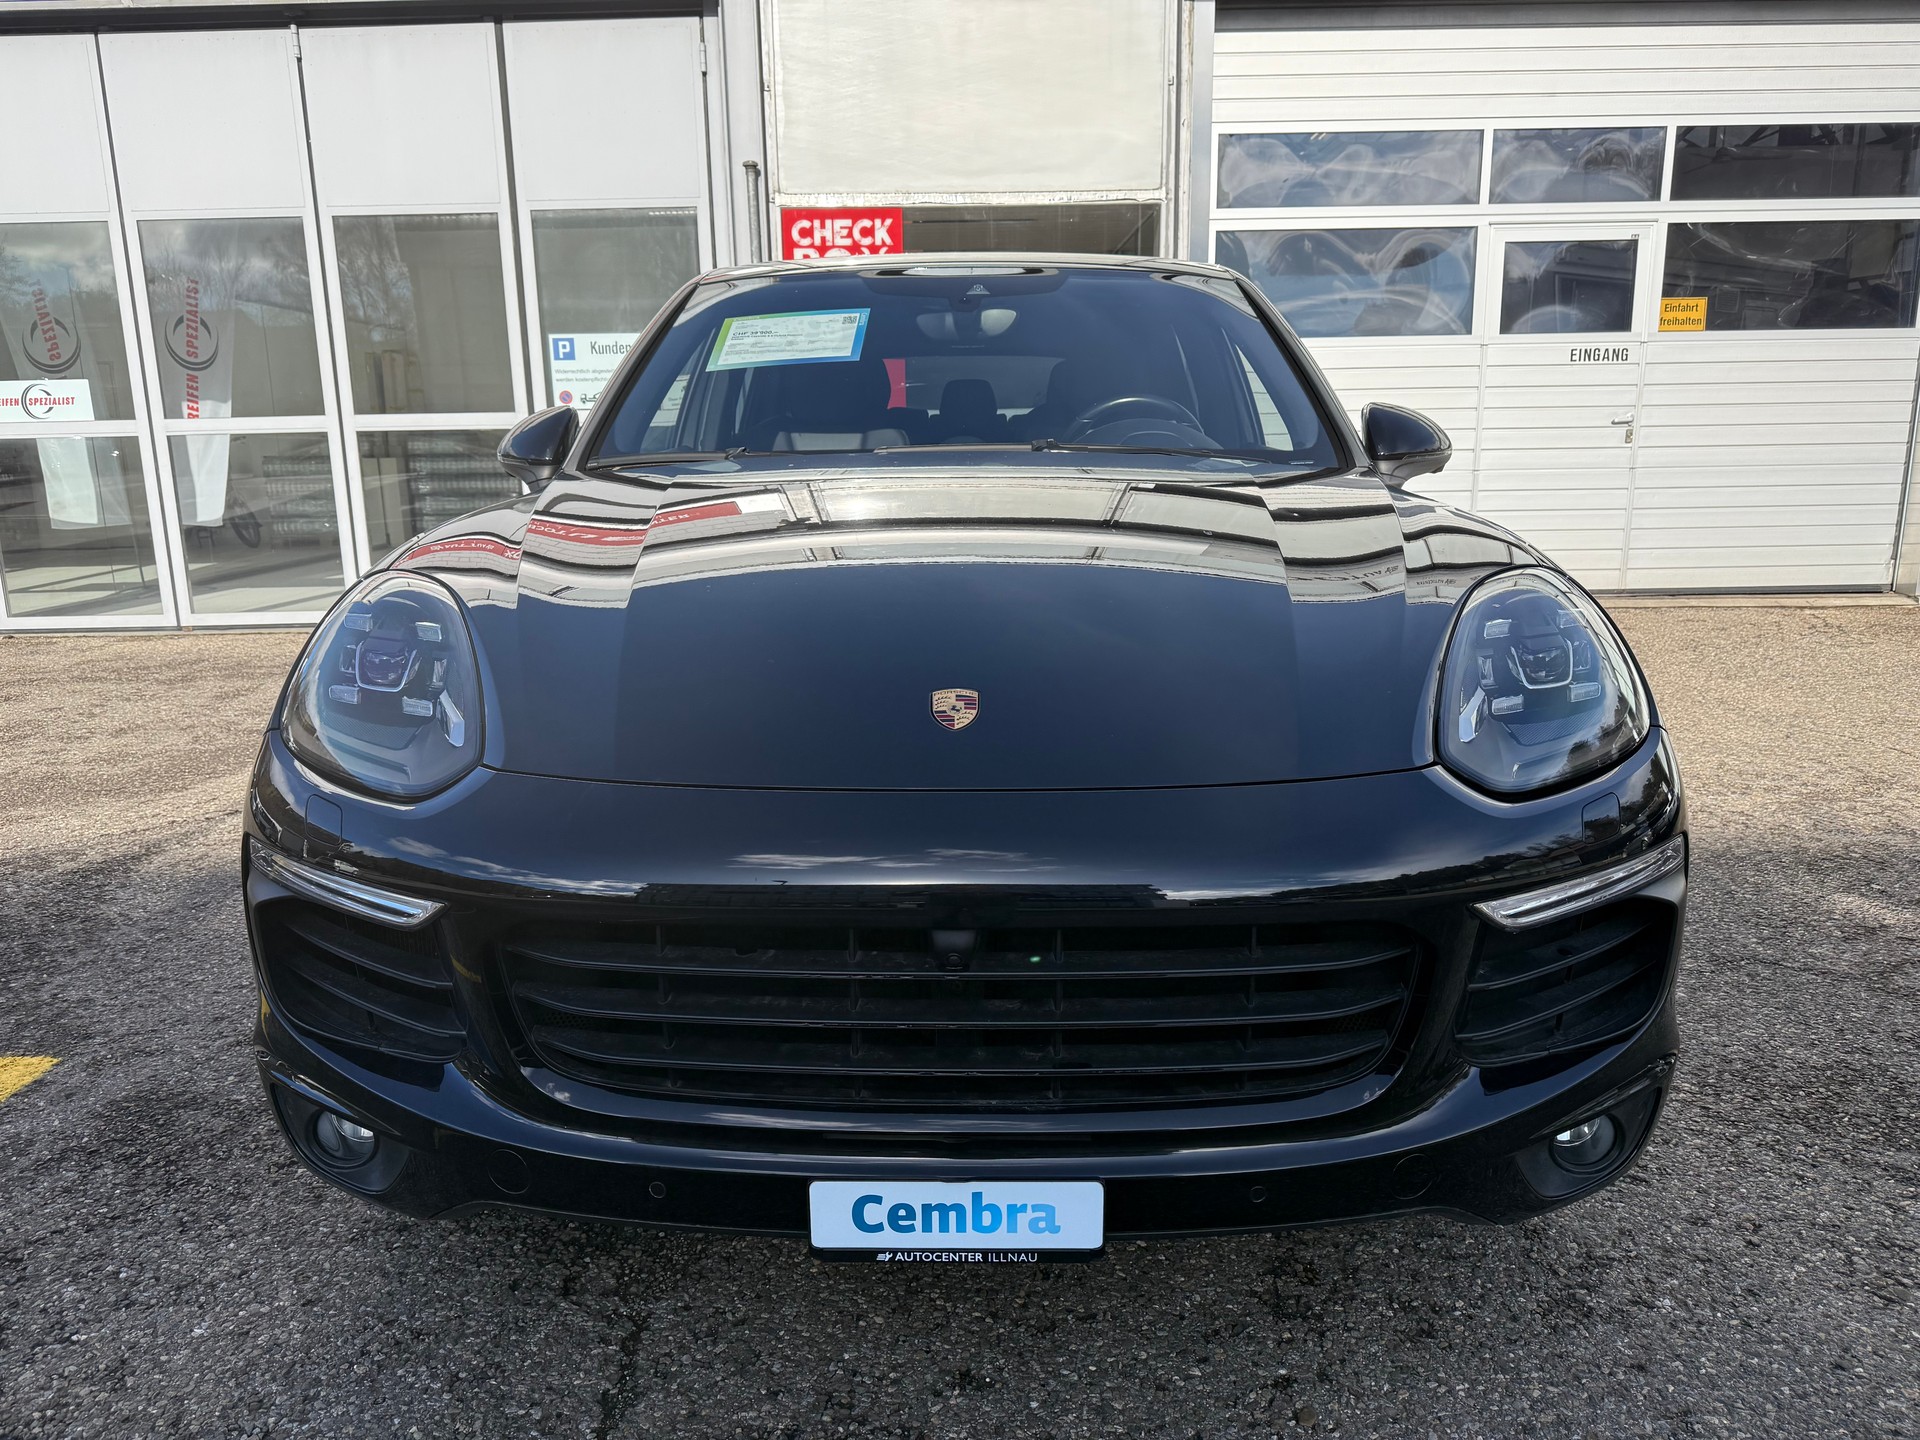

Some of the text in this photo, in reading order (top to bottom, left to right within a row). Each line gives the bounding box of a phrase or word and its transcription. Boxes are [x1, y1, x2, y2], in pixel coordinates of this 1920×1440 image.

[791, 218, 894, 246] CHECK
[1664, 303, 1699, 313] Einfahrt
[186, 276, 199, 359] SPEZIALIST
[1660, 316, 1702, 326] freihalten
[558, 341, 570, 359] P
[1570, 348, 1629, 362] EINGANG
[28, 396, 76, 406] SPEZIALIST
[851, 1191, 1061, 1234] Cembra
[895, 1251, 1038, 1263] AUTOCENTER ILLNAU
